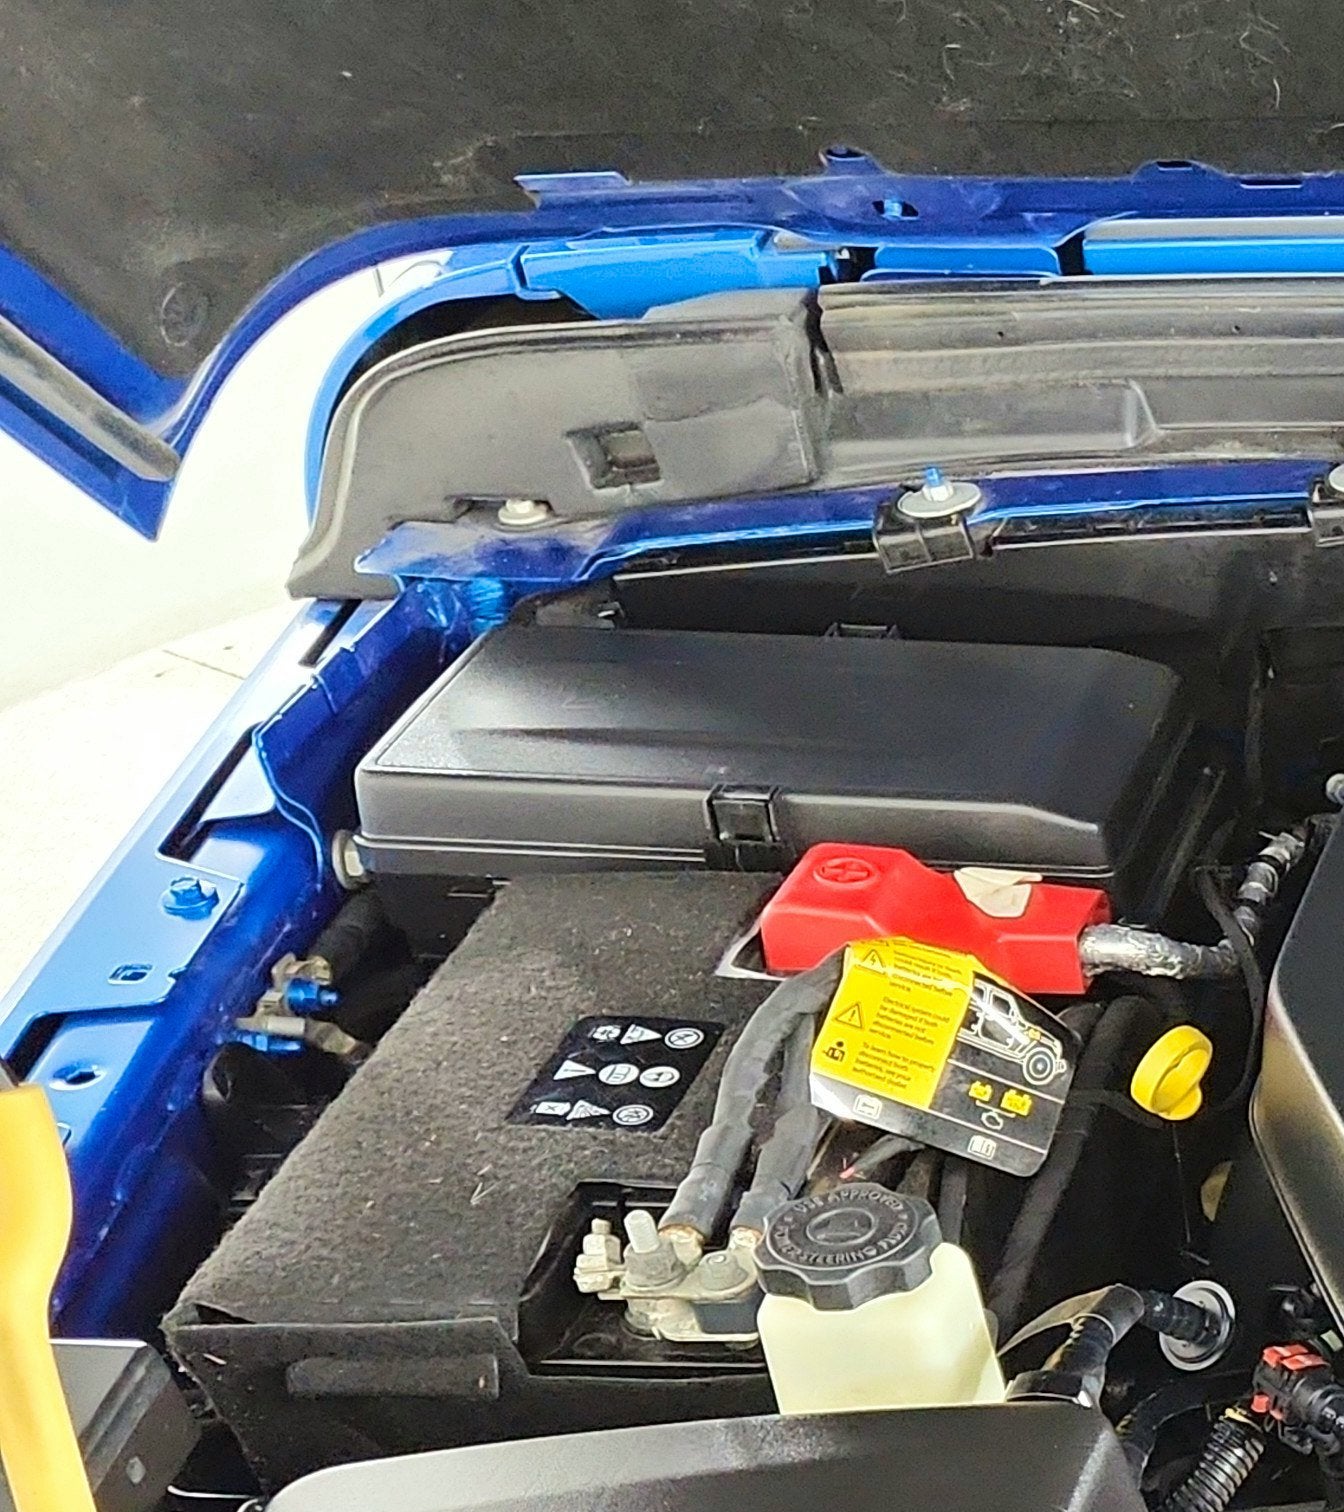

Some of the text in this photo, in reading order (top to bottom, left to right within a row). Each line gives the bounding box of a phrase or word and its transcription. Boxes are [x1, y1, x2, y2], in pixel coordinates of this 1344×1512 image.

[883, 997, 909, 1008] Electrical
[828, 1189, 904, 1211] APPROVED
[799, 1246, 878, 1265] STEERING
